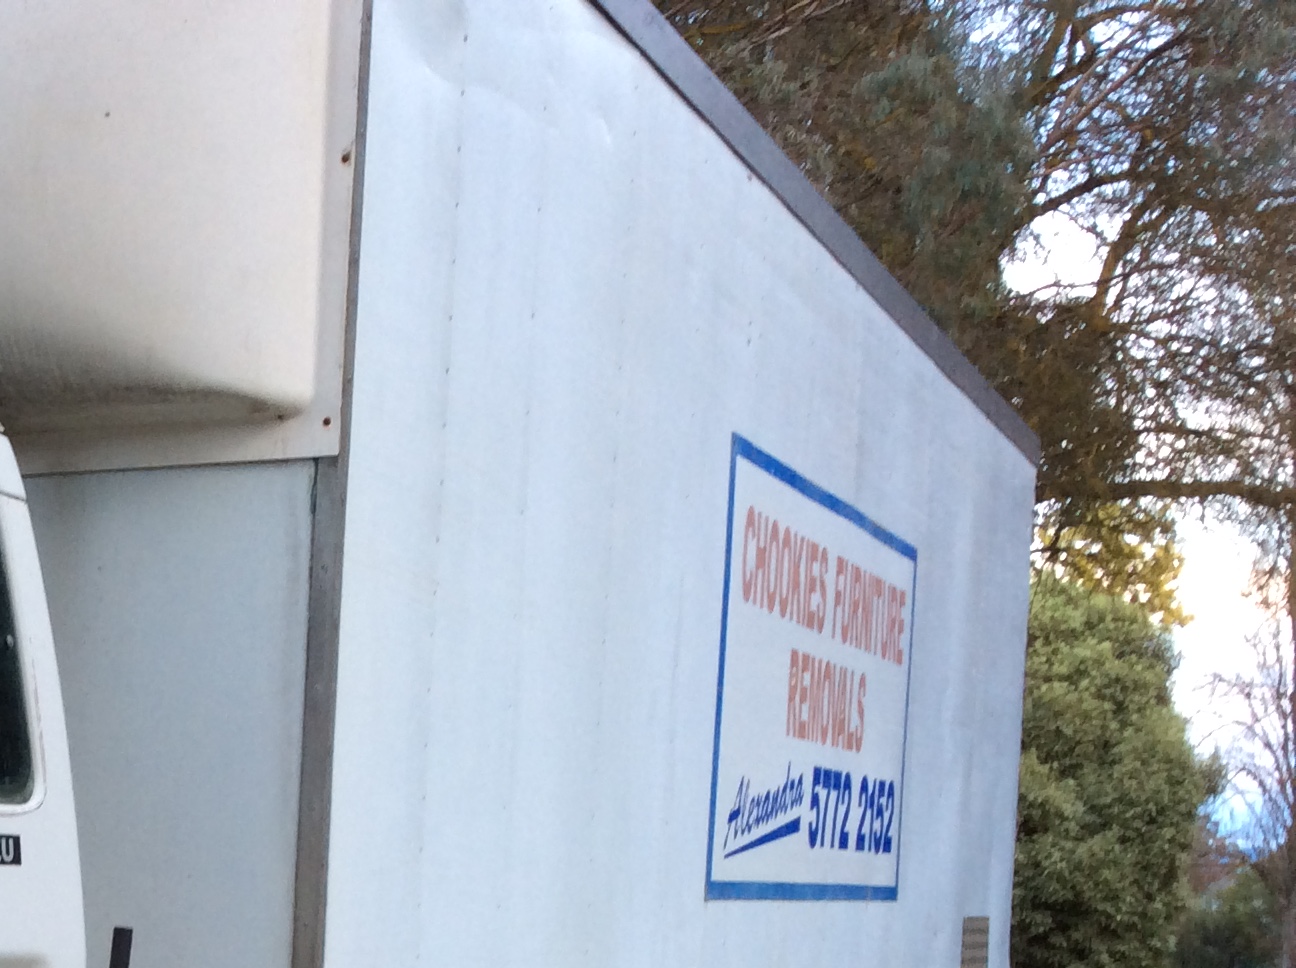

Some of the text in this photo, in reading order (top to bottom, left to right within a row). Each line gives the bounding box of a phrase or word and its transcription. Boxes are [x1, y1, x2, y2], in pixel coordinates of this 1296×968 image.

[742, 505, 906, 666] CHOOKIES FURNITURE
[786, 648, 867, 753] REMOVALS
[723, 761, 895, 854] Alexandra 5772 2152
